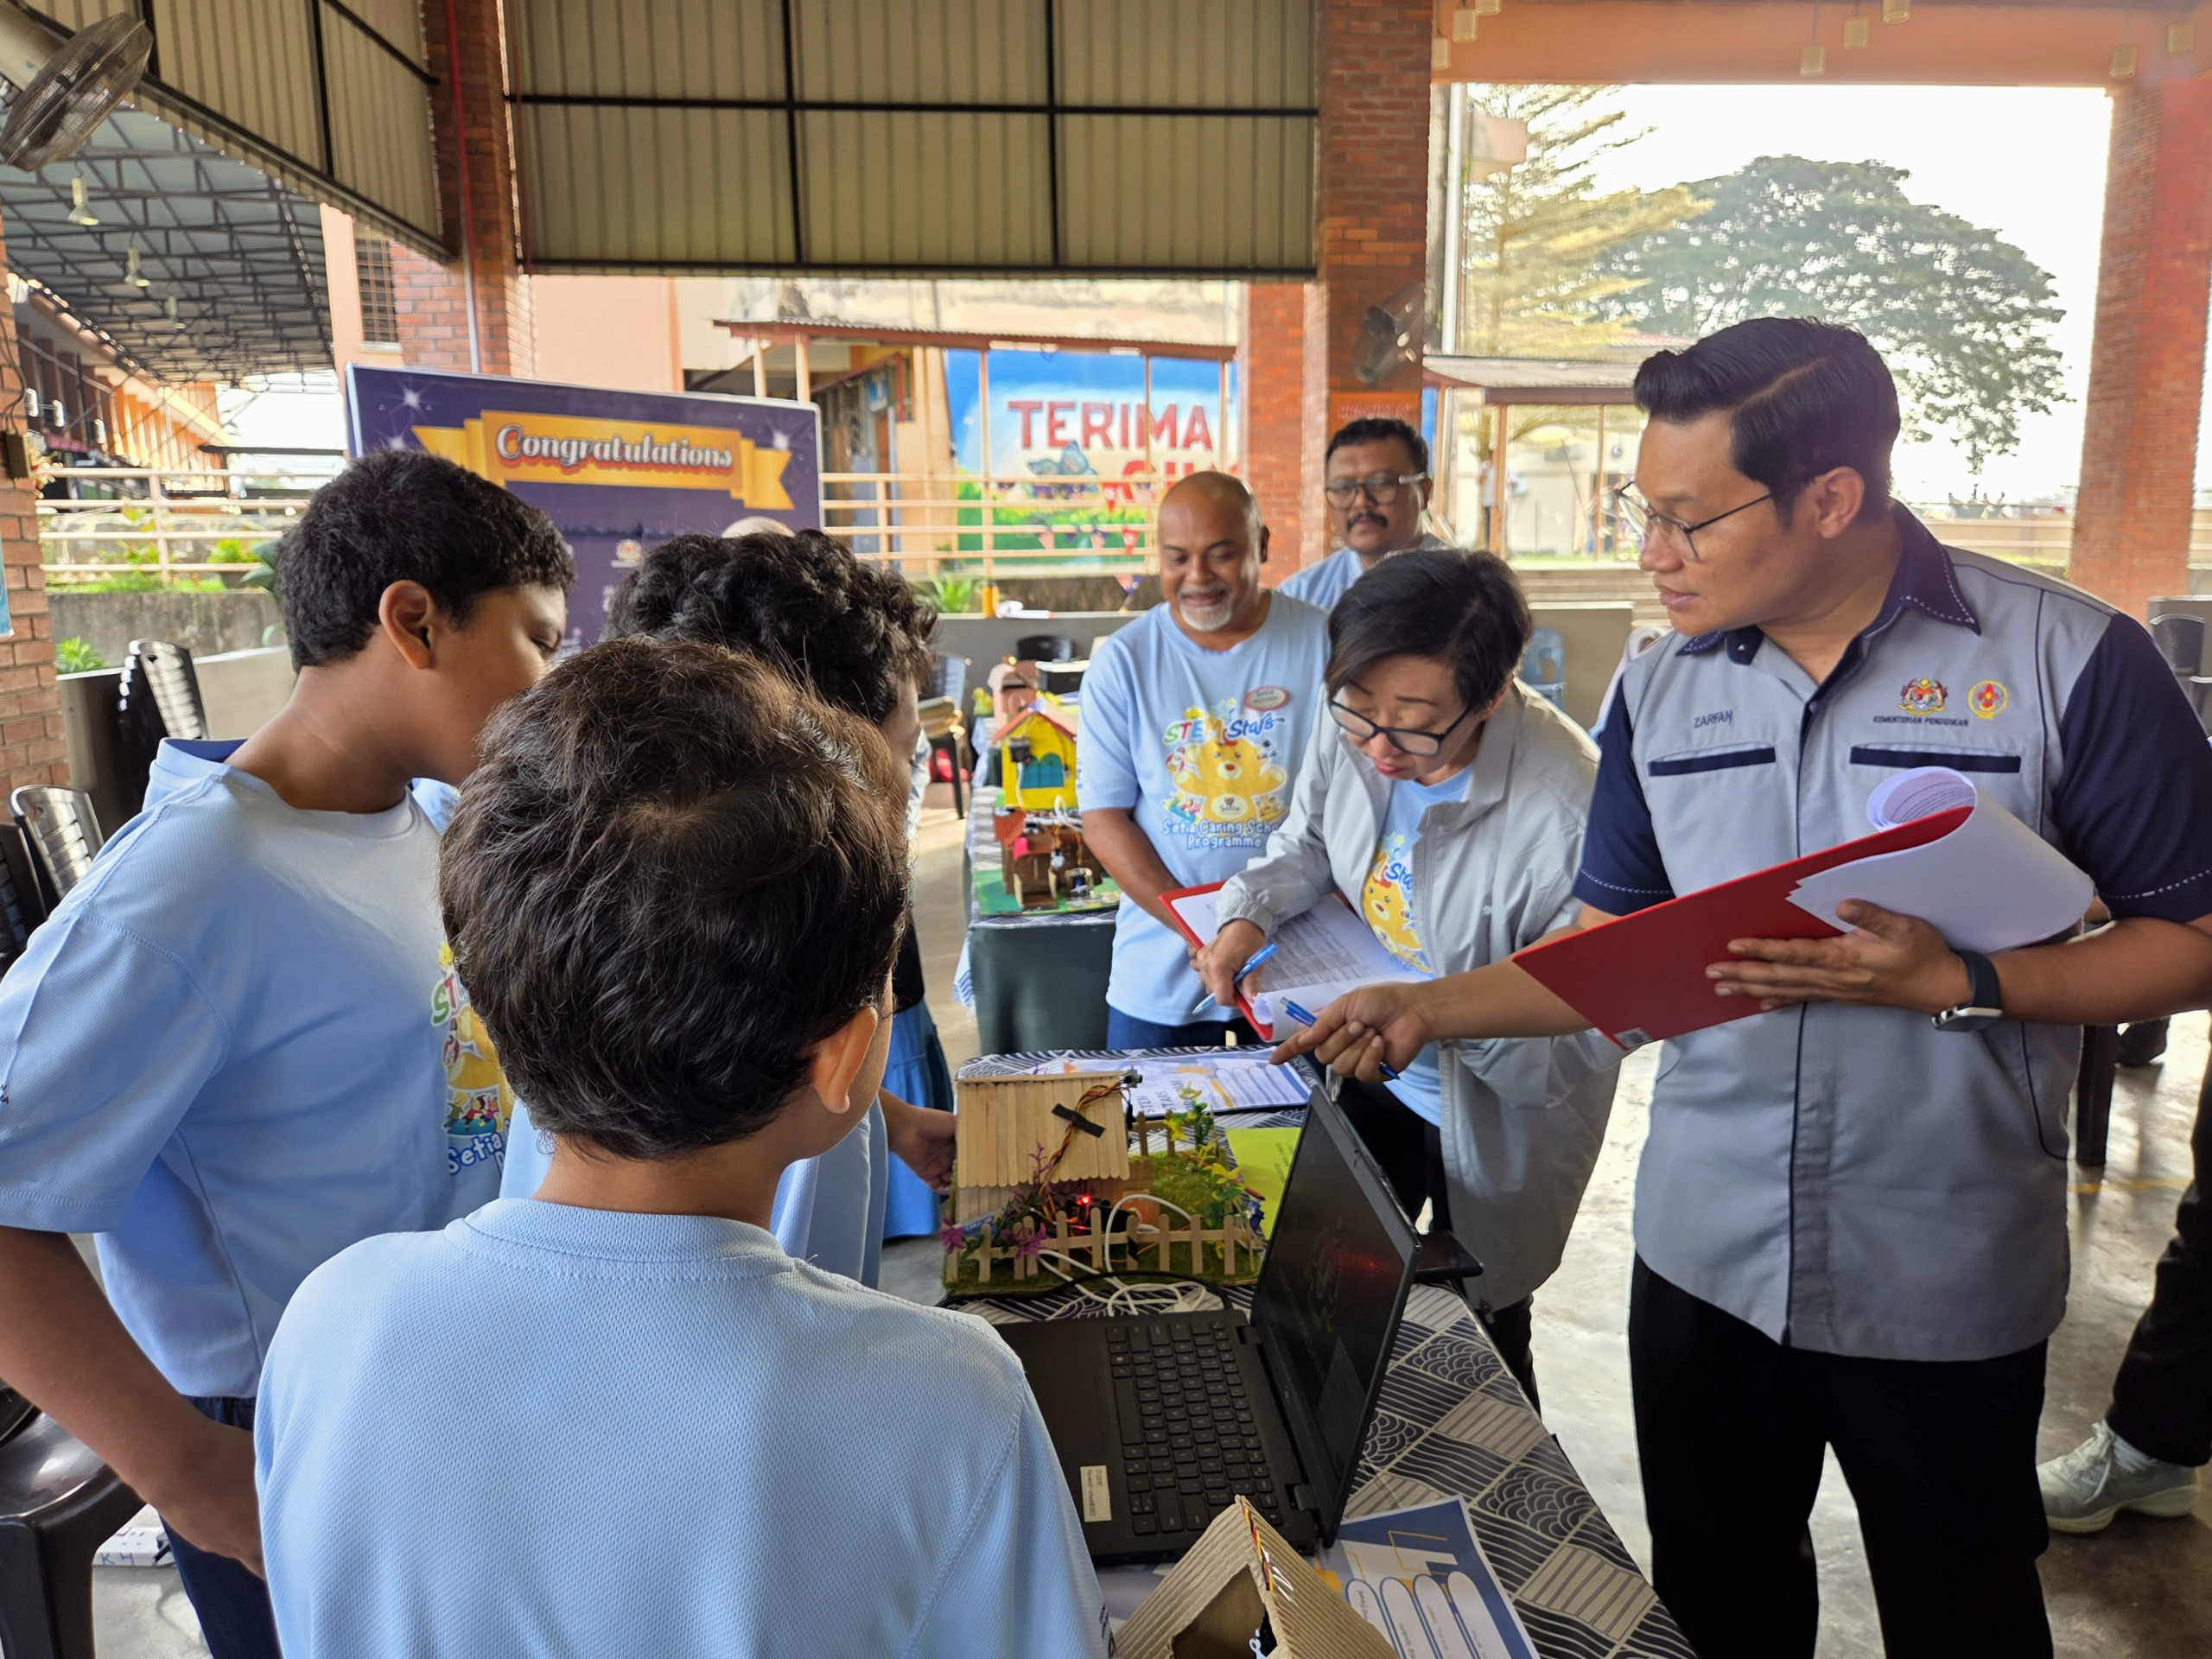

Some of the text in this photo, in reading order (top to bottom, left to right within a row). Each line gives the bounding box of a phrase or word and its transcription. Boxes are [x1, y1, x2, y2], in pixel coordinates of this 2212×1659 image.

[1007, 400, 1213, 449] TERIMA
[496, 423, 734, 474] Congratulations
[1163, 716, 1225, 745] STEM
[1693, 709, 1733, 728] ZARFAN
[1163, 817, 1281, 836] Setia Caring Scho
[1186, 836, 1262, 850] Programme
[447, 1131, 504, 1176] Setia
